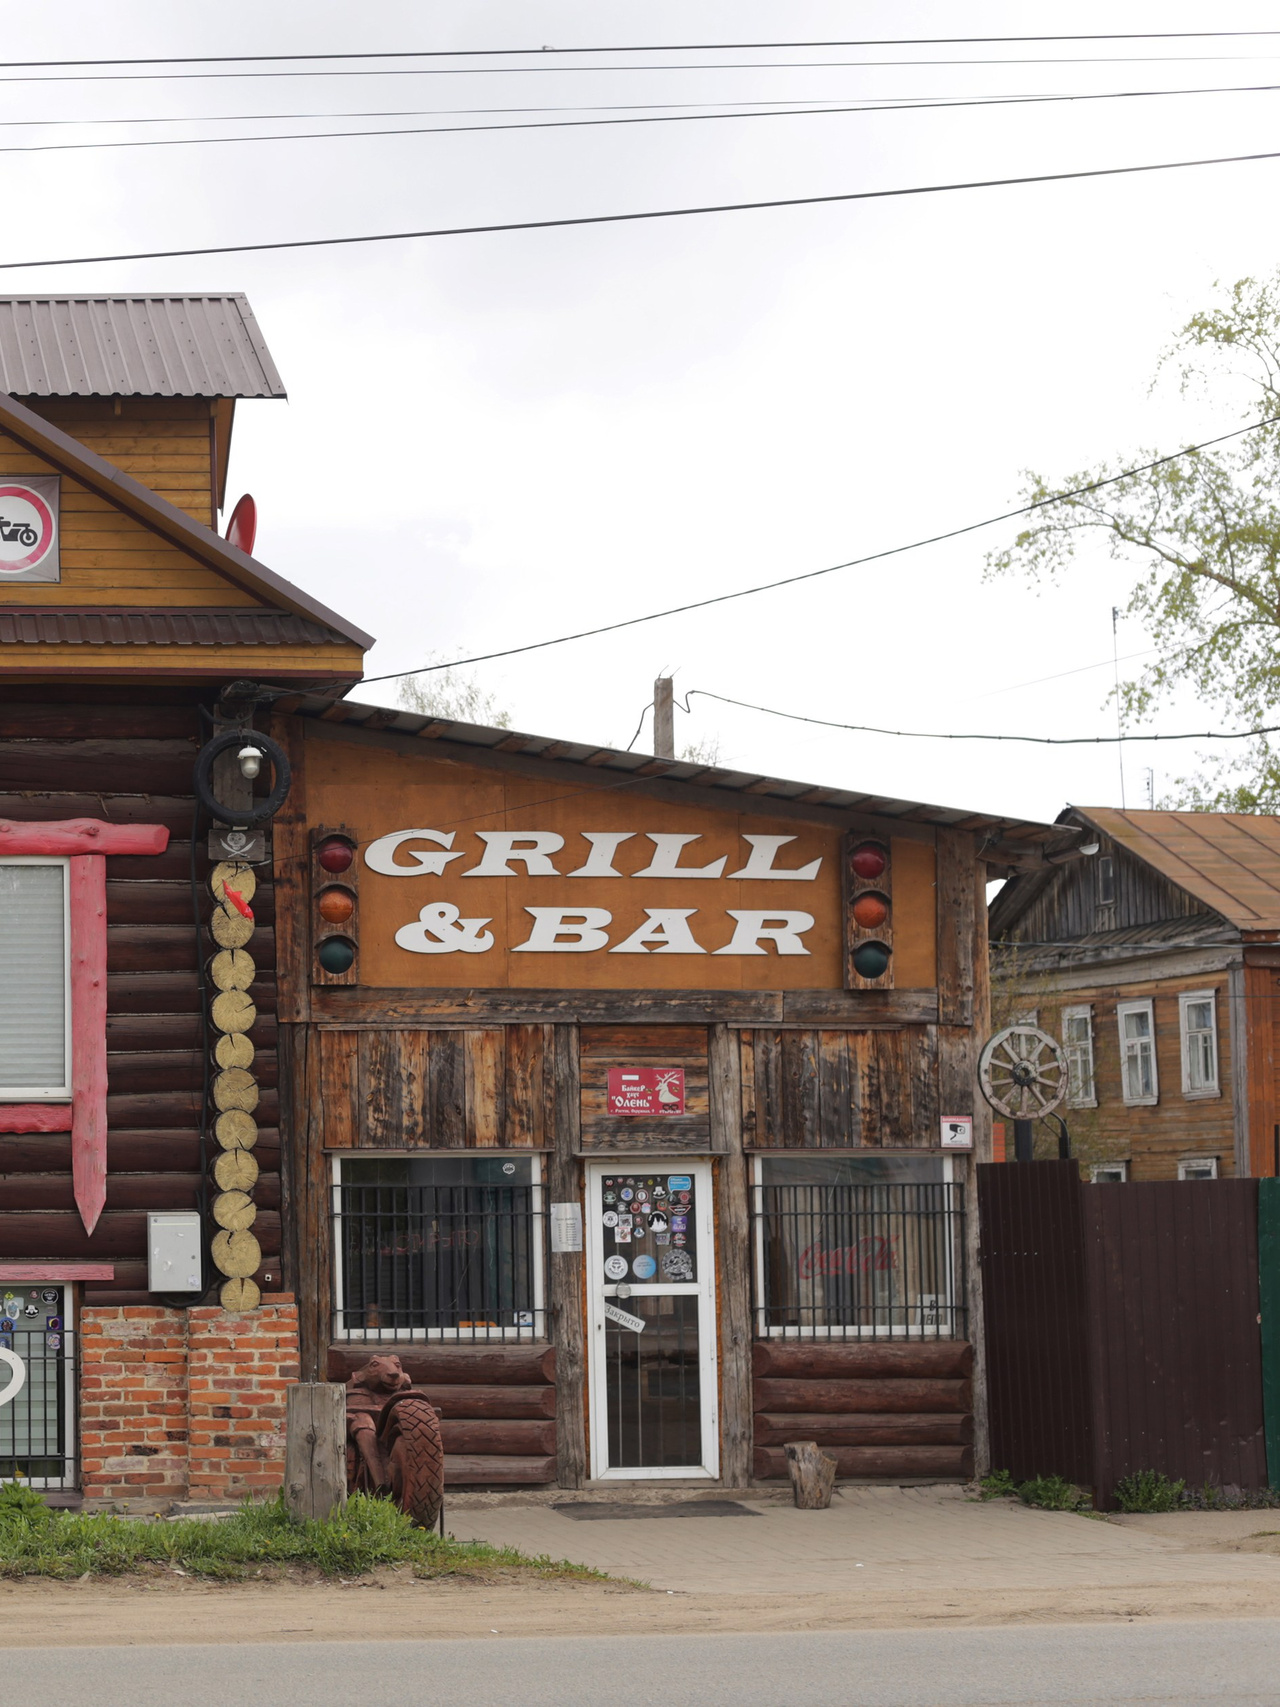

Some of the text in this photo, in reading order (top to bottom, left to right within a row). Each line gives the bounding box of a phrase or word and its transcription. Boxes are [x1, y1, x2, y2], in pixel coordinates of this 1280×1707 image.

[364, 828, 823, 881] GRILL
[394, 902, 816, 956] & BAR
[605, 1305, 640, 1328] Закрыто
